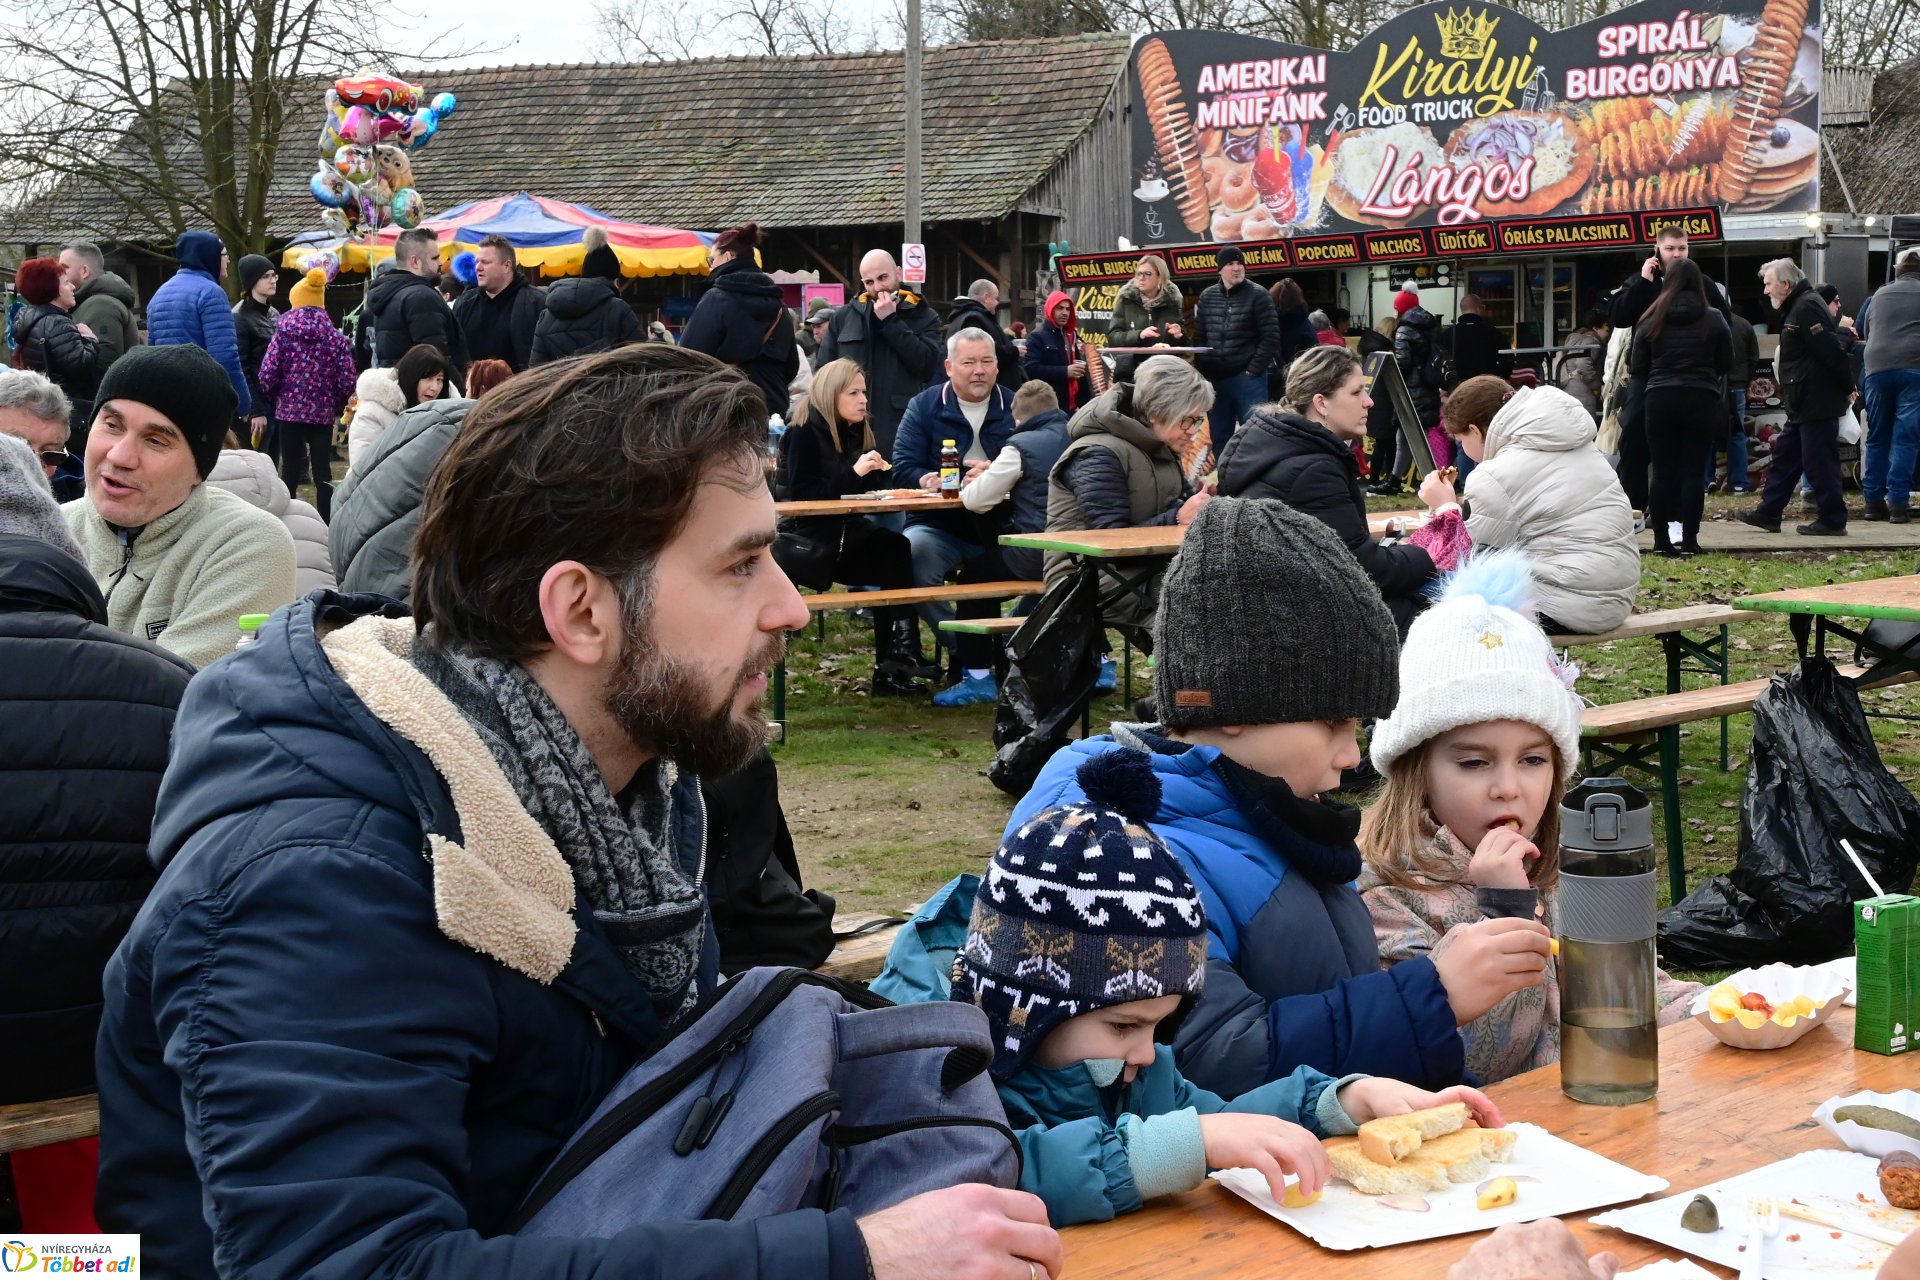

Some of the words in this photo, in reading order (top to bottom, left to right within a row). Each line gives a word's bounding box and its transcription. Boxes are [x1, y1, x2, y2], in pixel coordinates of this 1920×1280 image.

[1597, 9, 1708, 58] SPIRÁL
[1197, 54, 1327, 93] AMERIKAI
[1359, 35, 1538, 118] Királyi
[1565, 54, 1741, 100] BURGONYA
[1198, 86, 1328, 129] MINIFÁNK
[1358, 104, 1407, 127] FOOD
[1412, 98, 1473, 121] TRUCK
[1359, 143, 1536, 226] Lángos
[1369, 237, 1422, 256] NACHOS
[1439, 228, 1487, 250] ÜDÍTŐK
[1504, 226, 1545, 246] ÓRIÁS
[1546, 223, 1629, 243] PALACSINTA
[1177, 254, 1218, 270] AMERIK
[1243, 246, 1285, 265] NIFÁNK
[1297, 243, 1355, 261] POPCORN
[1065, 260, 1104, 278] SPIRÁL
[1103, 259, 1140, 275] BURGO
